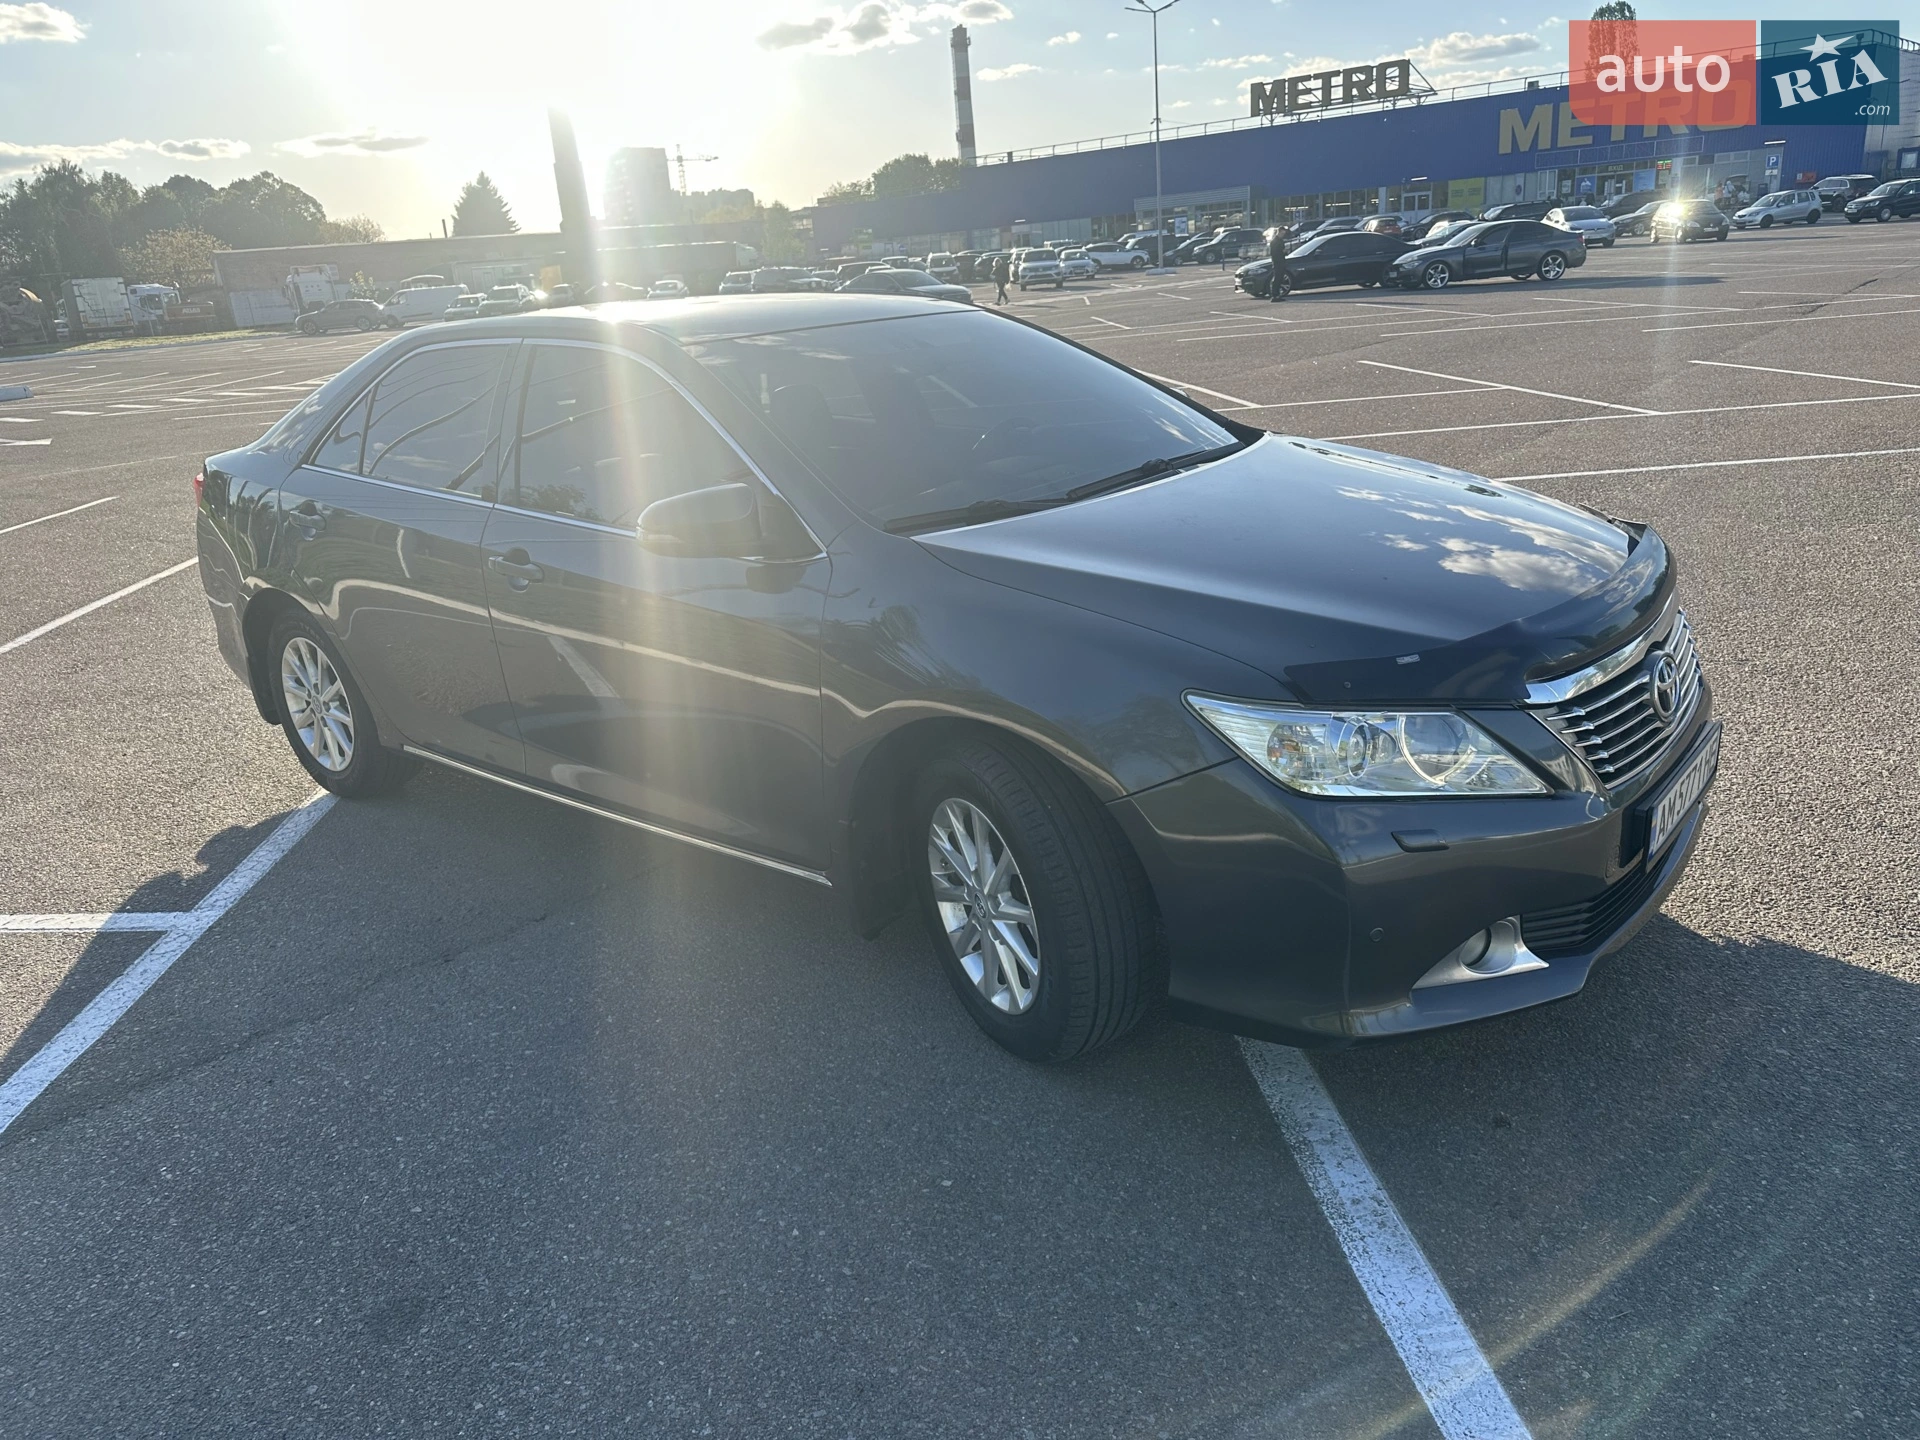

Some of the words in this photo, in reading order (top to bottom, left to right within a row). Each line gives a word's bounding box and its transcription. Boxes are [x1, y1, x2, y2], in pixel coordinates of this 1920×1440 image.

[1250, 58, 1410, 117] METRO
[1498, 79, 1753, 154] METRO
[1769, 156, 1777, 166] P
[1677, 756, 1703, 816] 5771
